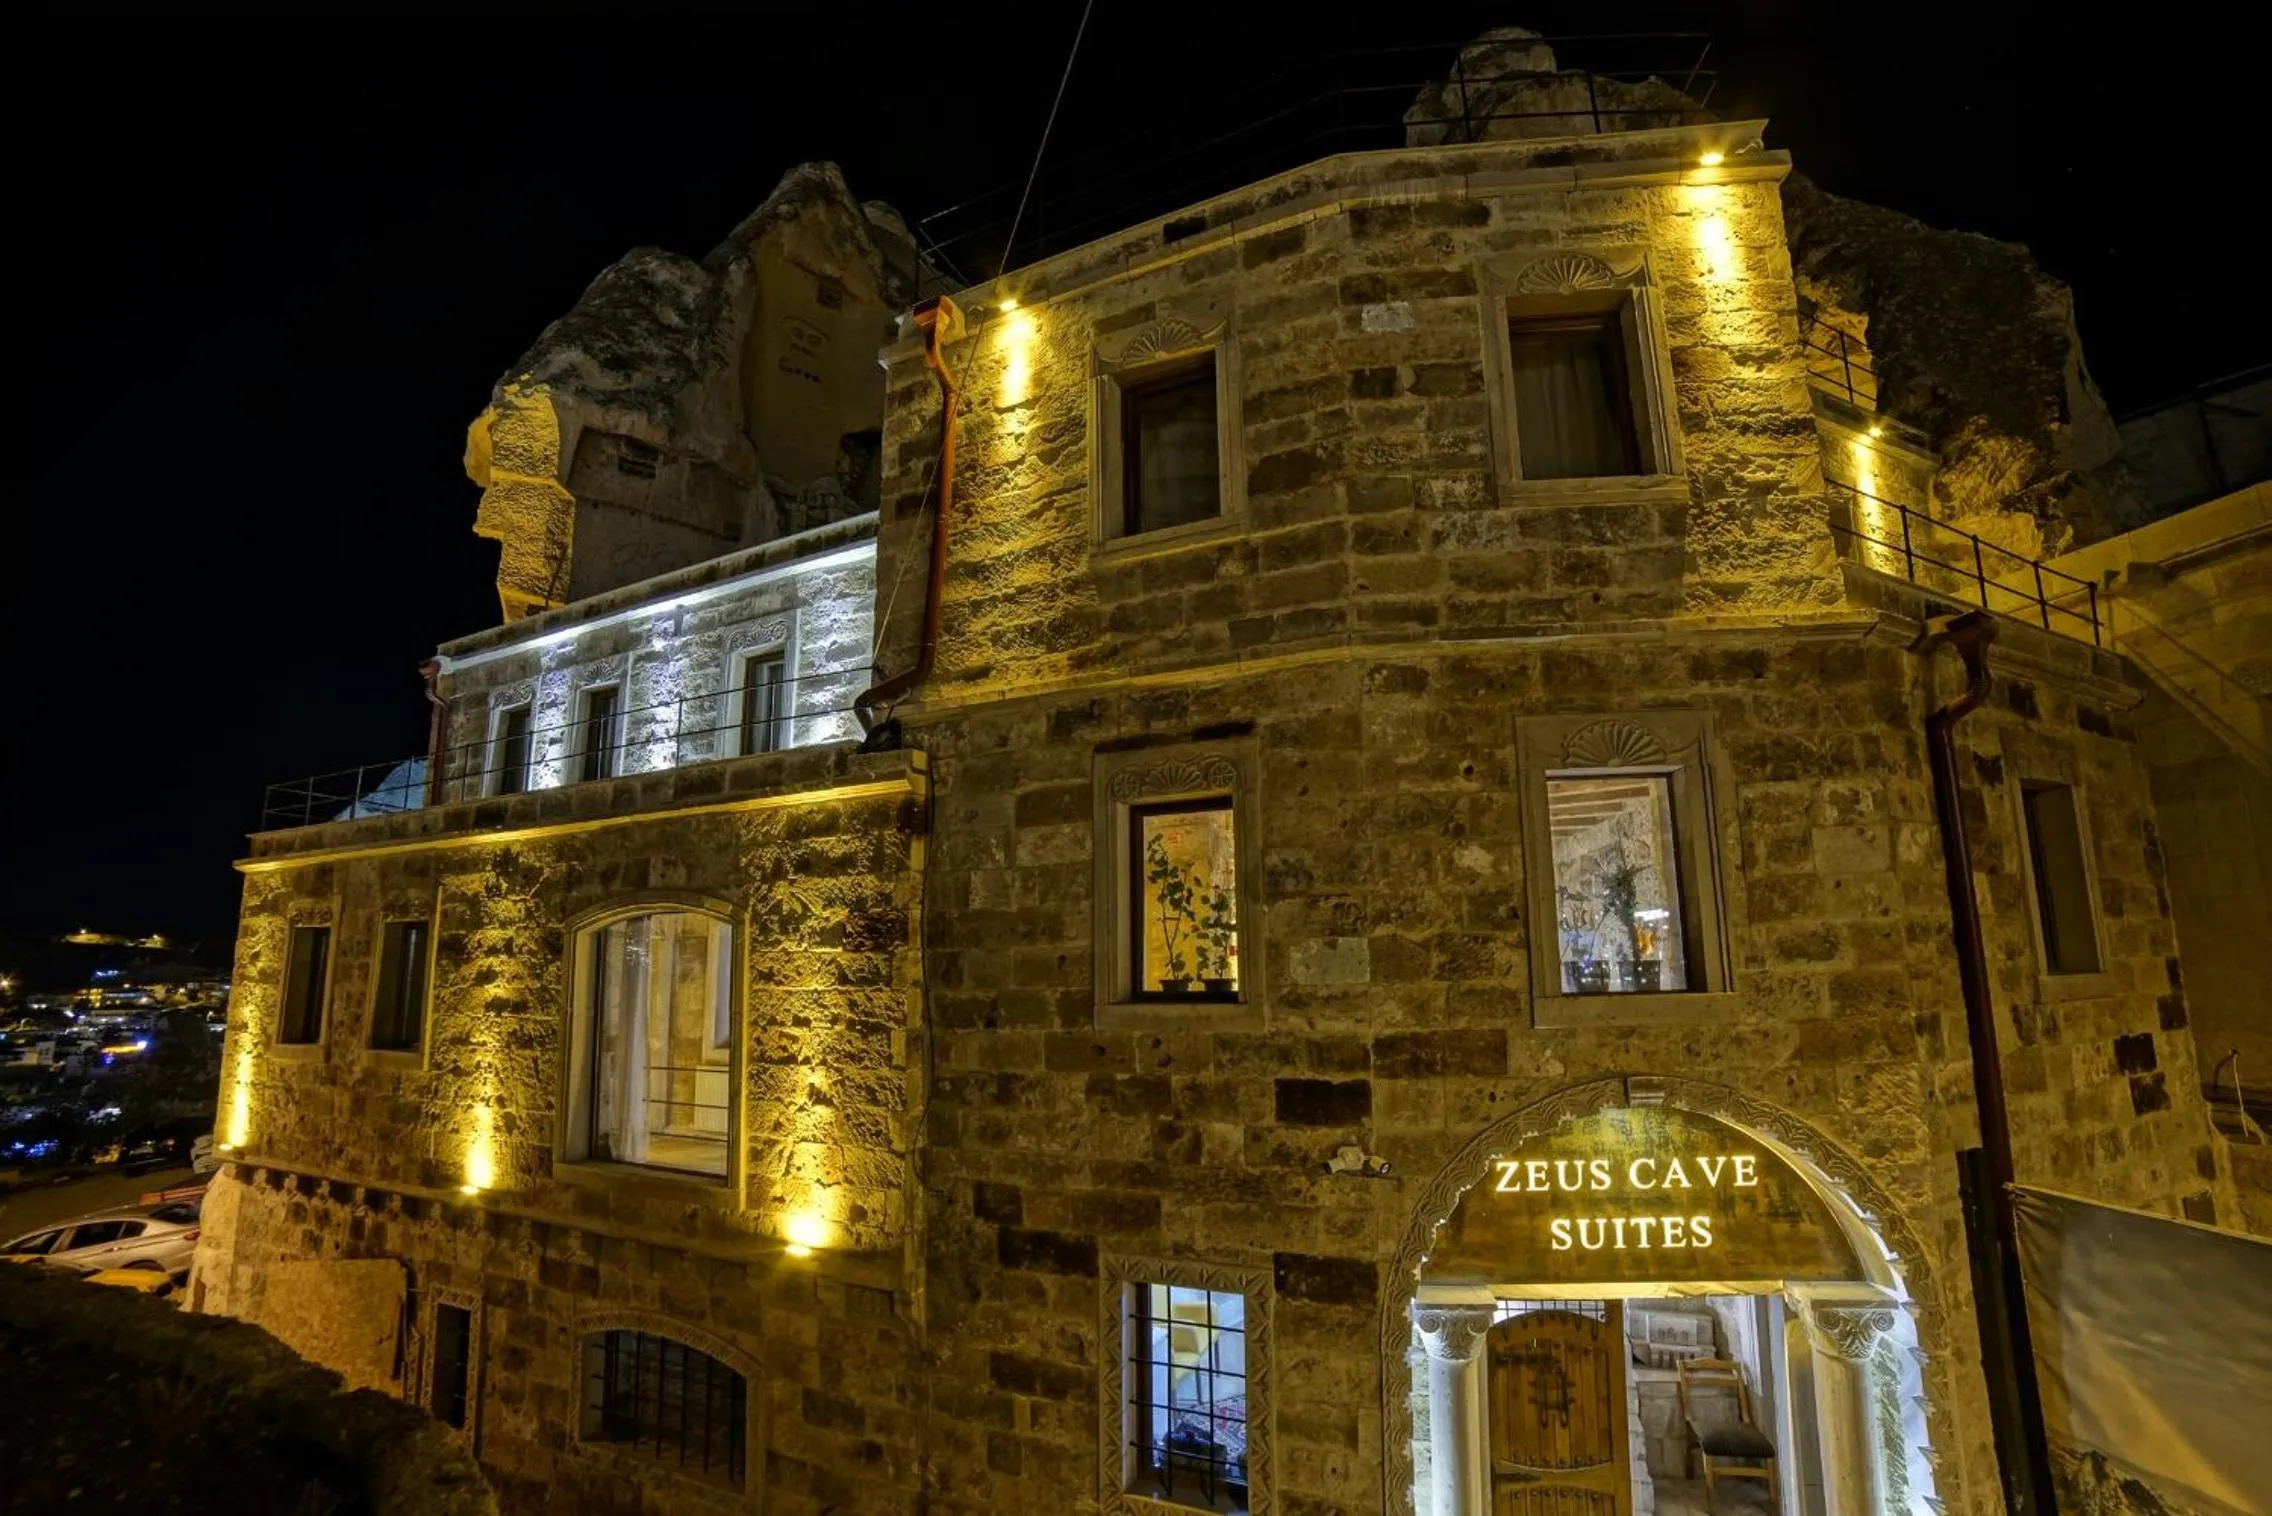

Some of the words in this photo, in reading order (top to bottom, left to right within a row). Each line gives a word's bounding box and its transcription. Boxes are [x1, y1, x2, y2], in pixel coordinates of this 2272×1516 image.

[1495, 1159, 1612, 1192] ZEUS
[1628, 1156, 1758, 1189] CAVE
[1551, 1215, 1713, 1250] SUITES
